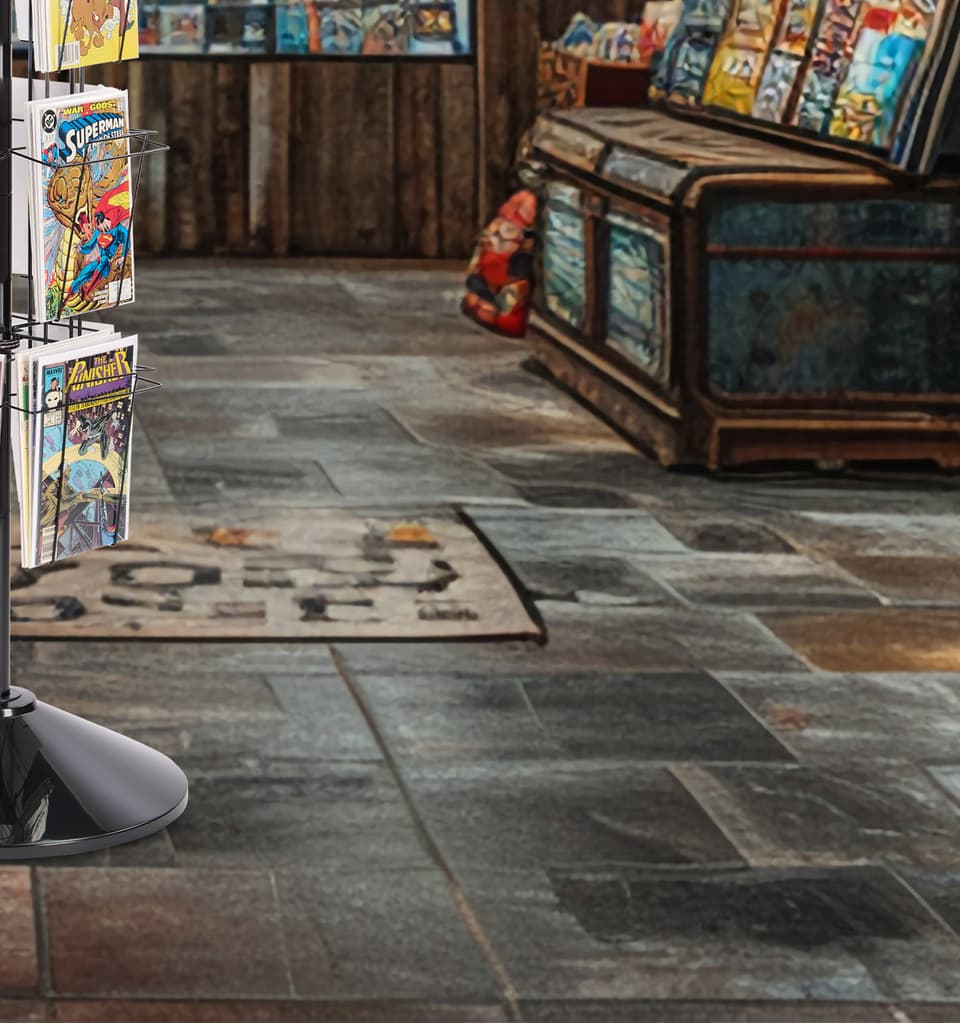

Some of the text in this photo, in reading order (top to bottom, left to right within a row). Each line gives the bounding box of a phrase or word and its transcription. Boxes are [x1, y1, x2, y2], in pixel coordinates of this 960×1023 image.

[63, 106, 83, 115] WAR
[65, 117, 124, 164] SUPERMAN
[65, 351, 131, 394] PUNISHER
